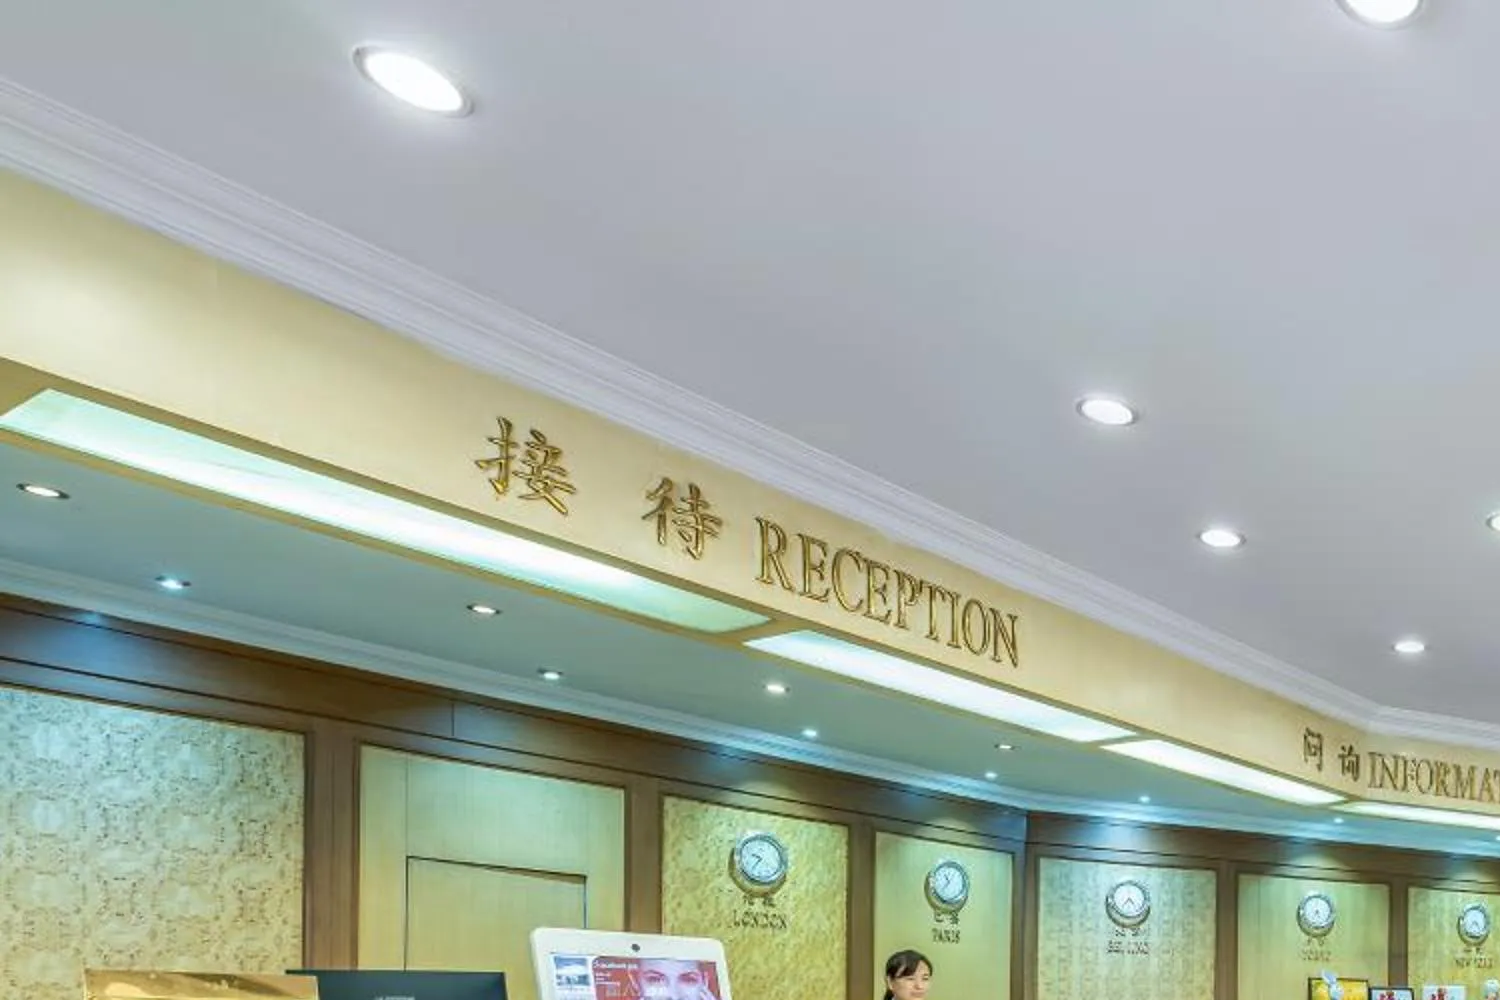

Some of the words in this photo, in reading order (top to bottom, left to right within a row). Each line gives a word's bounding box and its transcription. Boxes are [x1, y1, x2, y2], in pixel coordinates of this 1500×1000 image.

[474, 416, 723, 560] 接待
[755, 516, 1018, 668] RECEPTION
[1303, 727, 1361, 782] 问询
